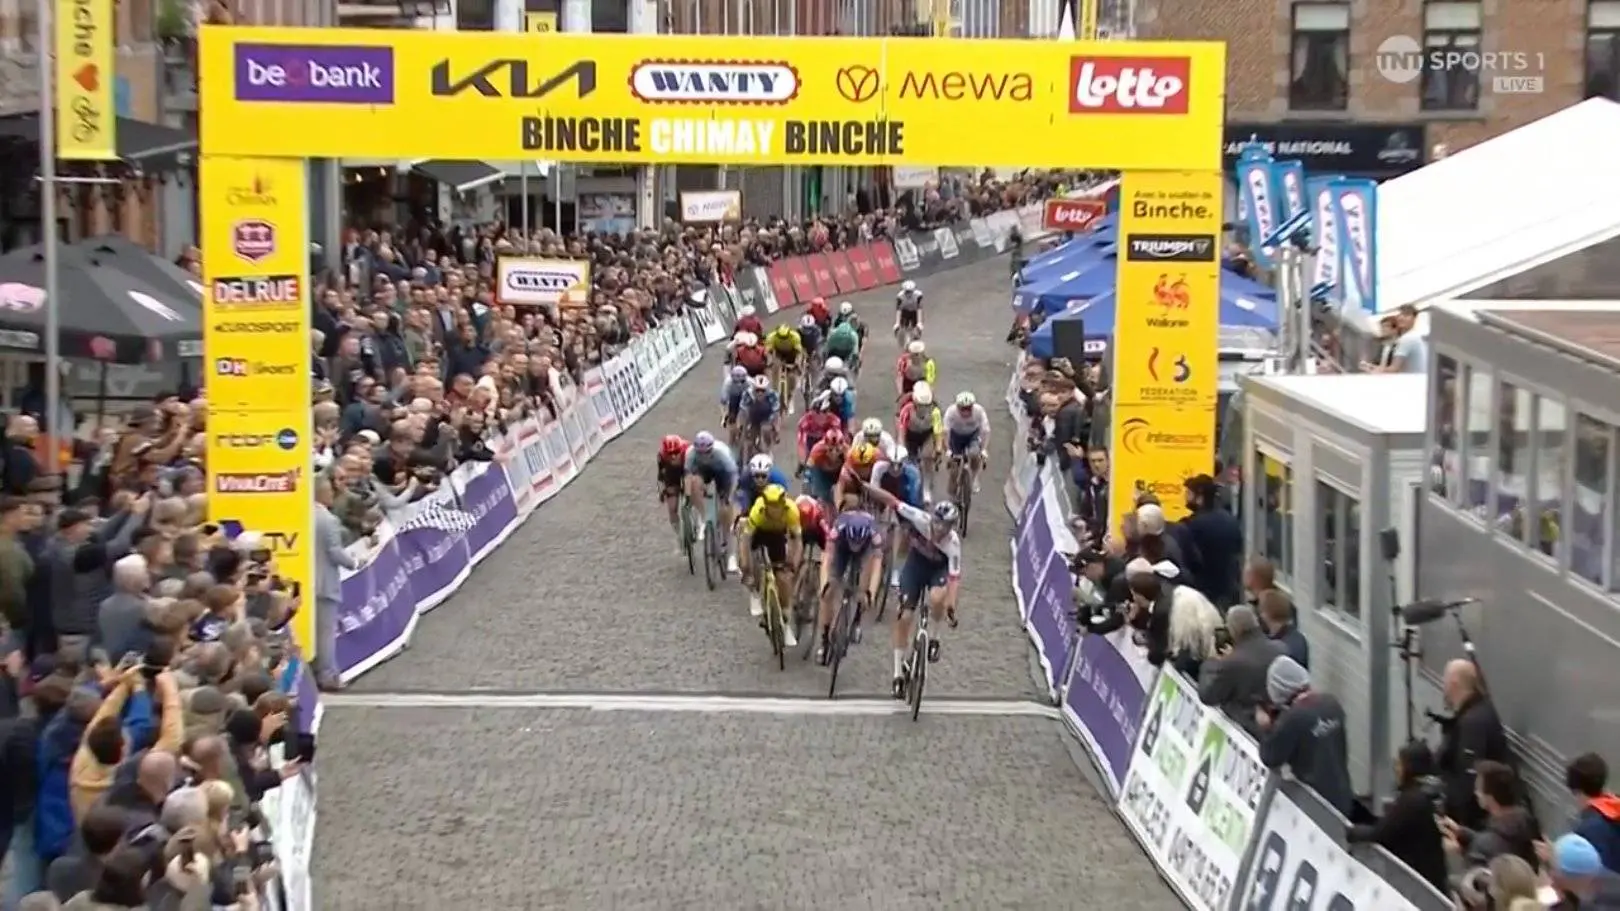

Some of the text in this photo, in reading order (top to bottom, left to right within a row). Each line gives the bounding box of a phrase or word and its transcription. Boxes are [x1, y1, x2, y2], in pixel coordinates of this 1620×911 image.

[649, 71, 779, 93] WANTY
[521, 115, 904, 156] BINCHE CHIMAY BINCHE
[1278, 141, 1353, 155] NATIONAL
[1133, 200, 1214, 219] Binche.
[1132, 240, 1194, 257] TRIUMPH
[214, 279, 298, 303] DELRUE
